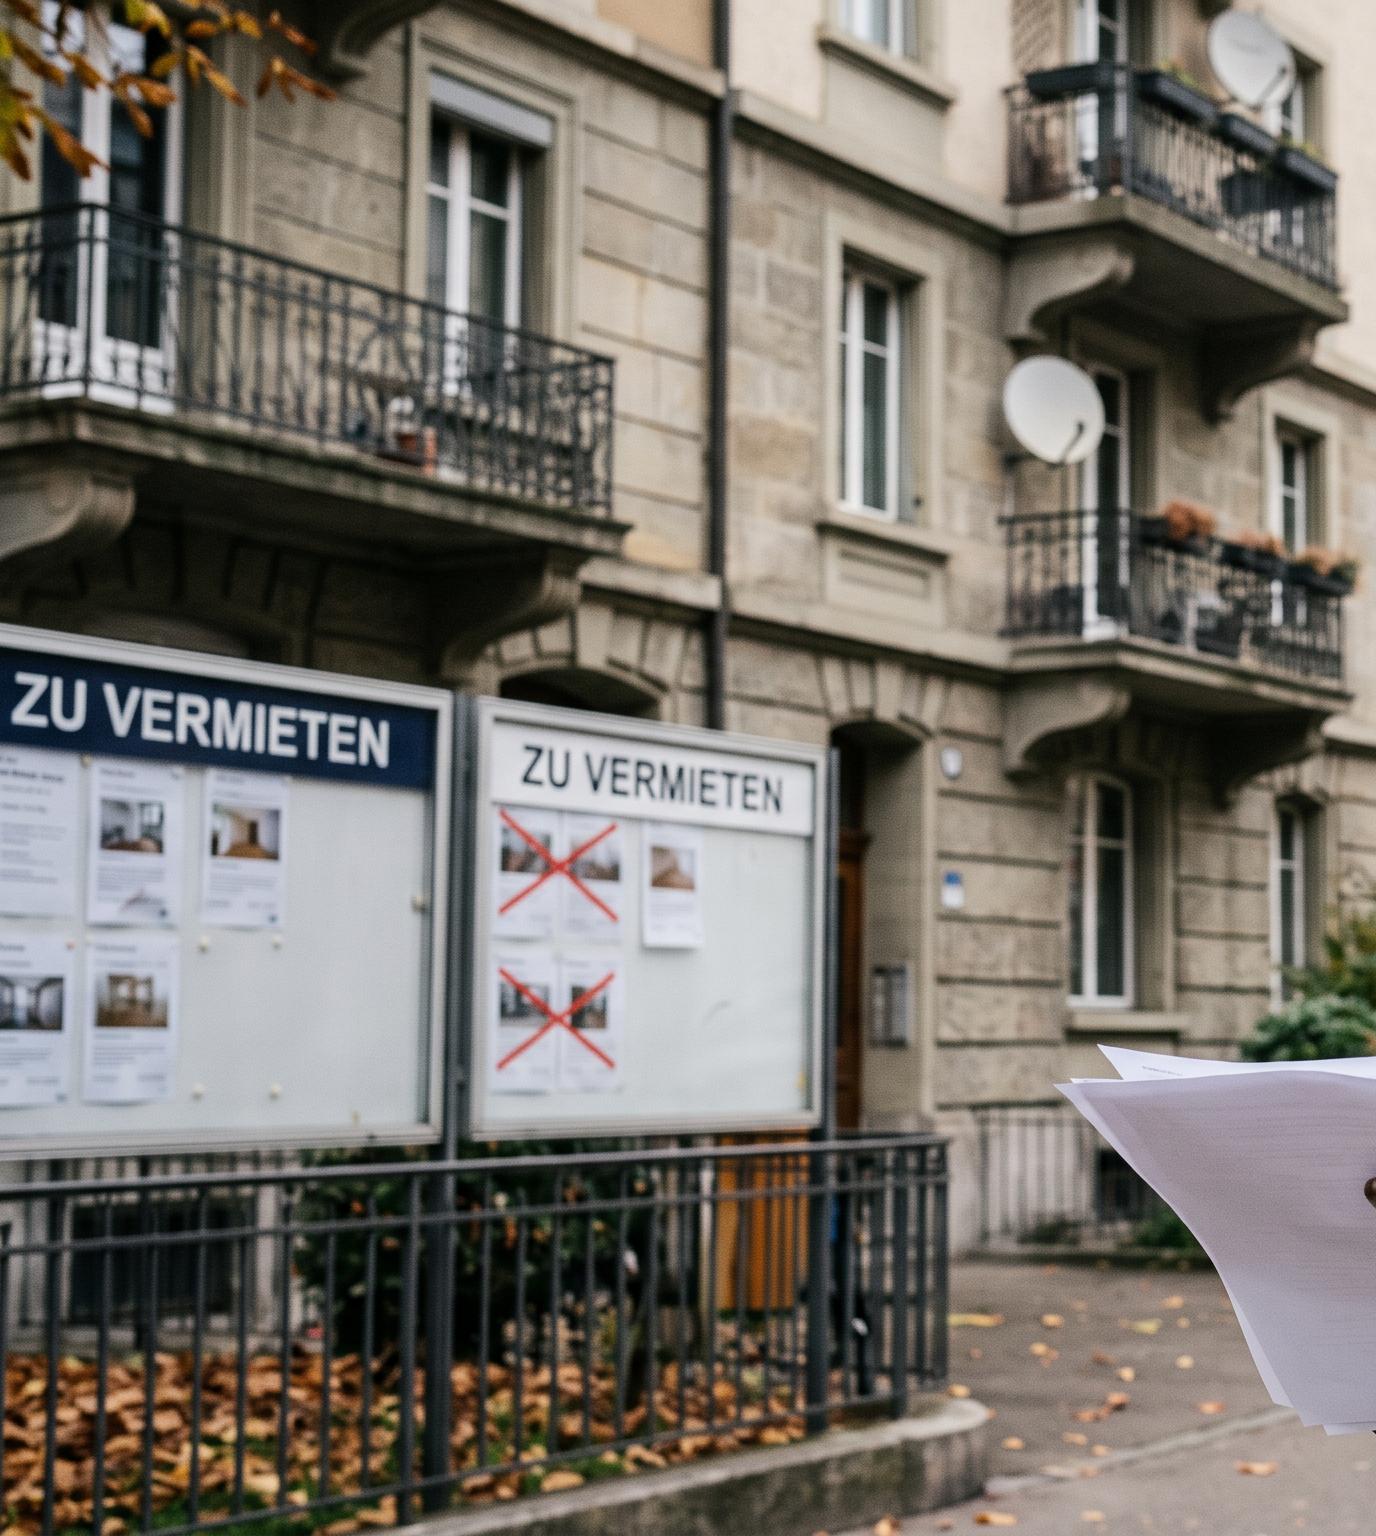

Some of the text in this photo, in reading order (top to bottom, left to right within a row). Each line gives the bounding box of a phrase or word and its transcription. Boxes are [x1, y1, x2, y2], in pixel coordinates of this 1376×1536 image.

[11, 671, 390, 768] ZU VERMIETEN
[521, 745, 783, 813] ZU VERMIETEN
